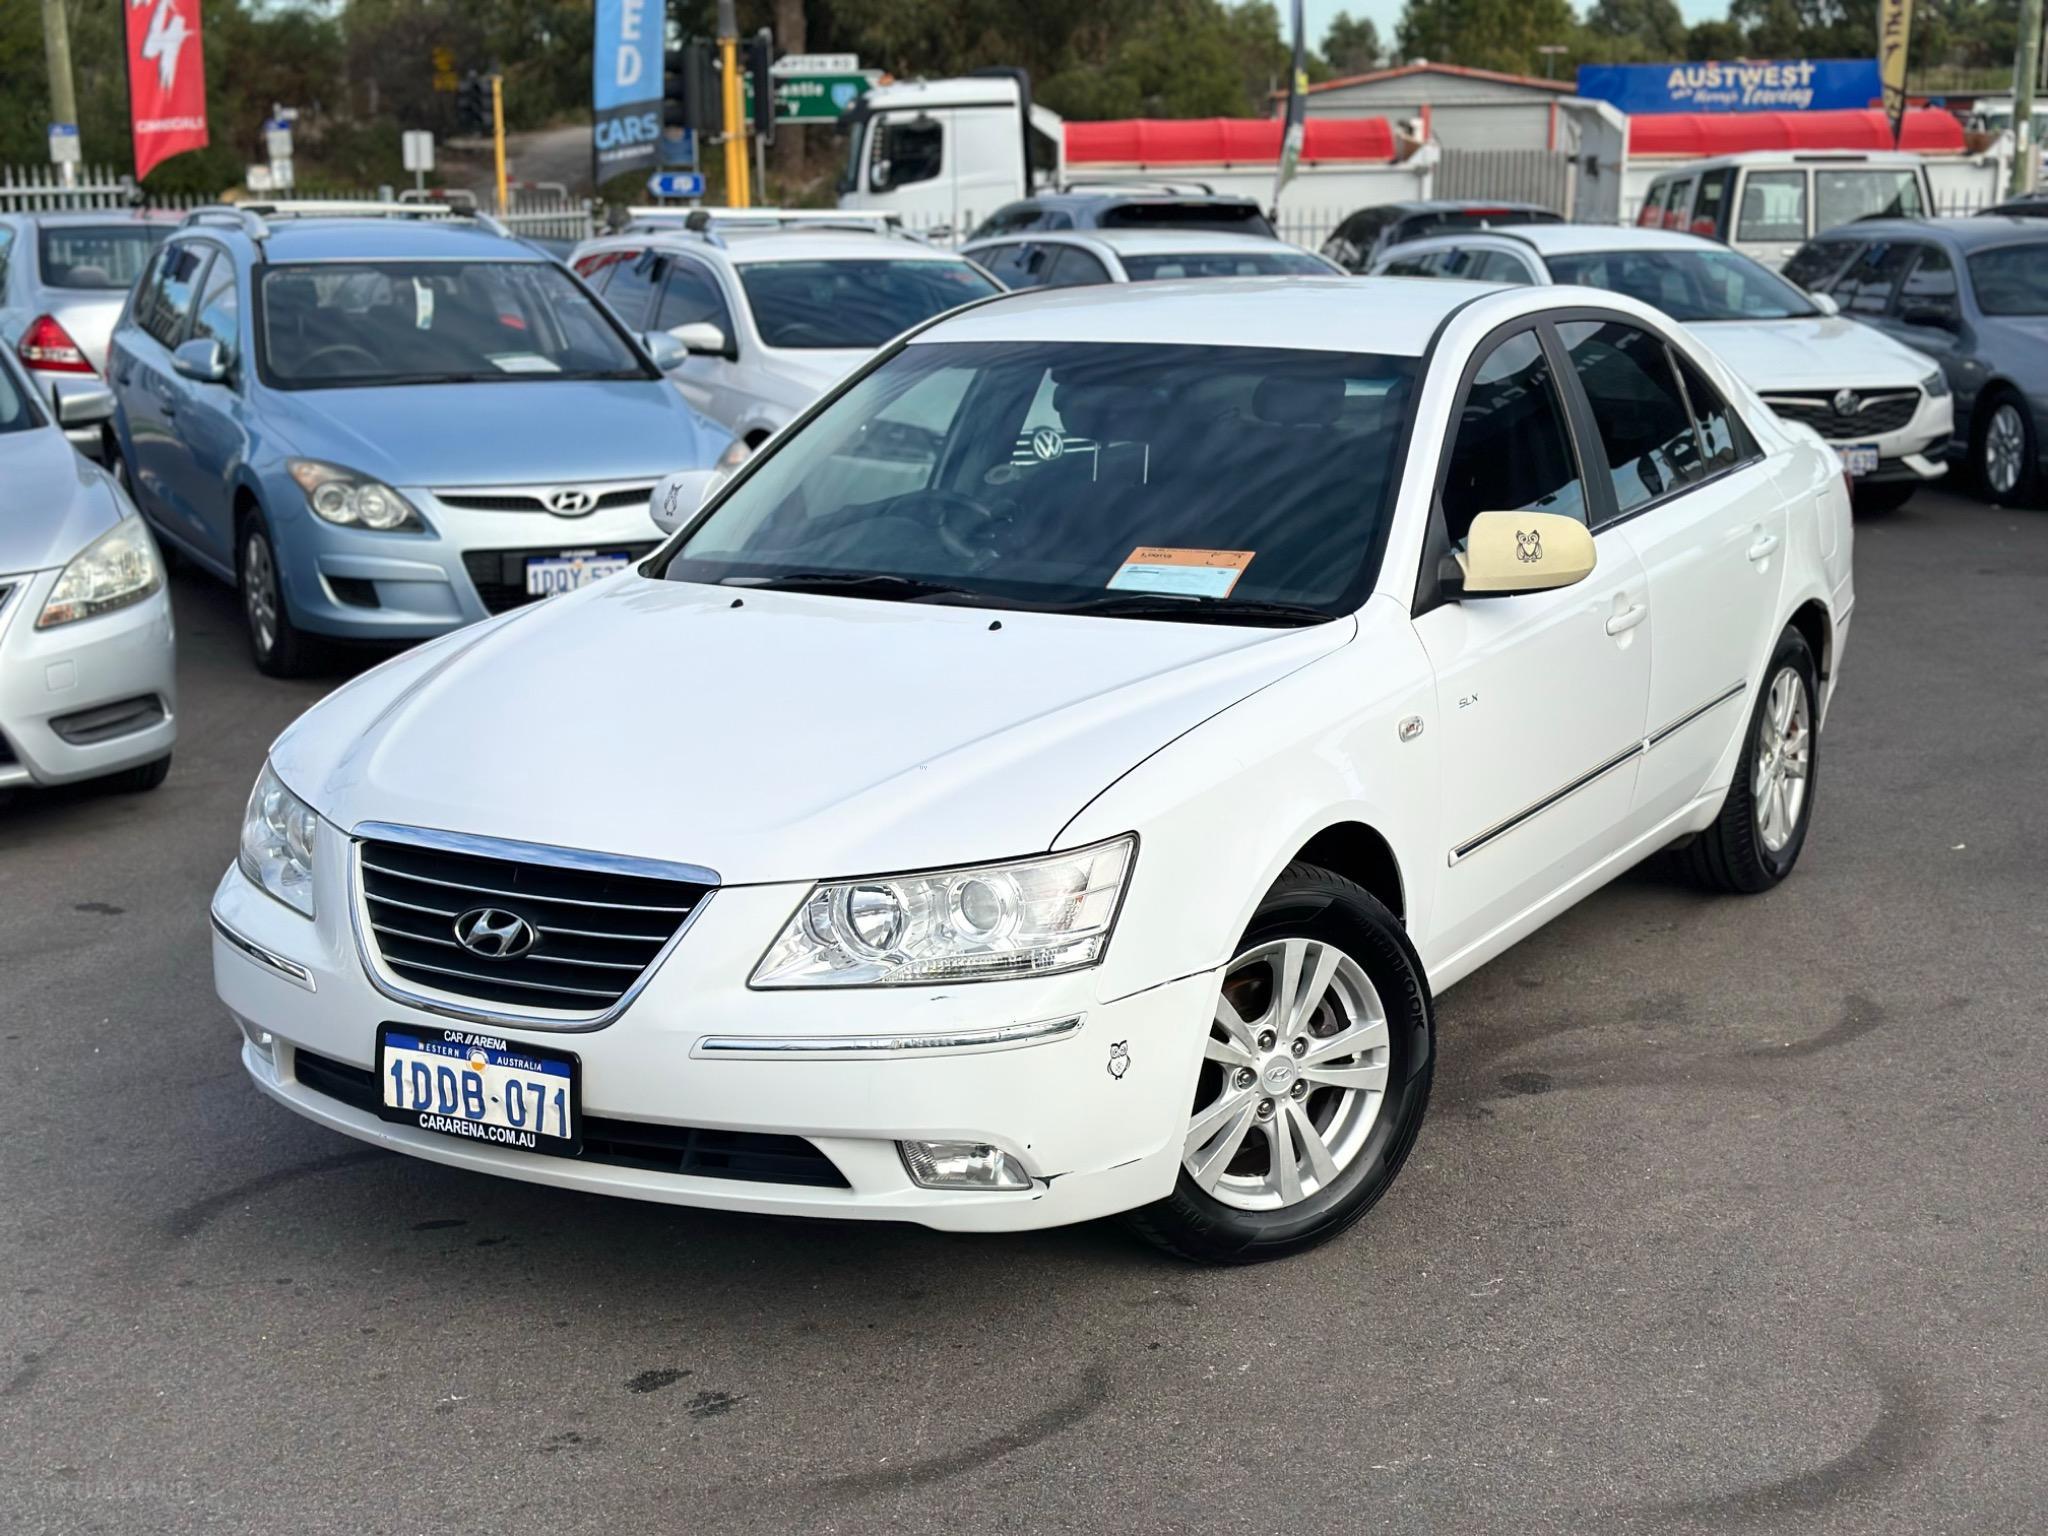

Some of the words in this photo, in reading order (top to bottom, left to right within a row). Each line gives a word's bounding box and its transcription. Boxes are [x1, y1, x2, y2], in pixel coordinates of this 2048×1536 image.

[1667, 59, 1816, 89] AUSTWEST
[594, 112, 660, 150] CARS
[444, 1030, 464, 1045] CAR
[418, 1042, 460, 1059] WESTERN
[496, 1056, 543, 1073] AUSTRALIA
[418, 1112, 536, 1149] CARARENA.COM.AU
